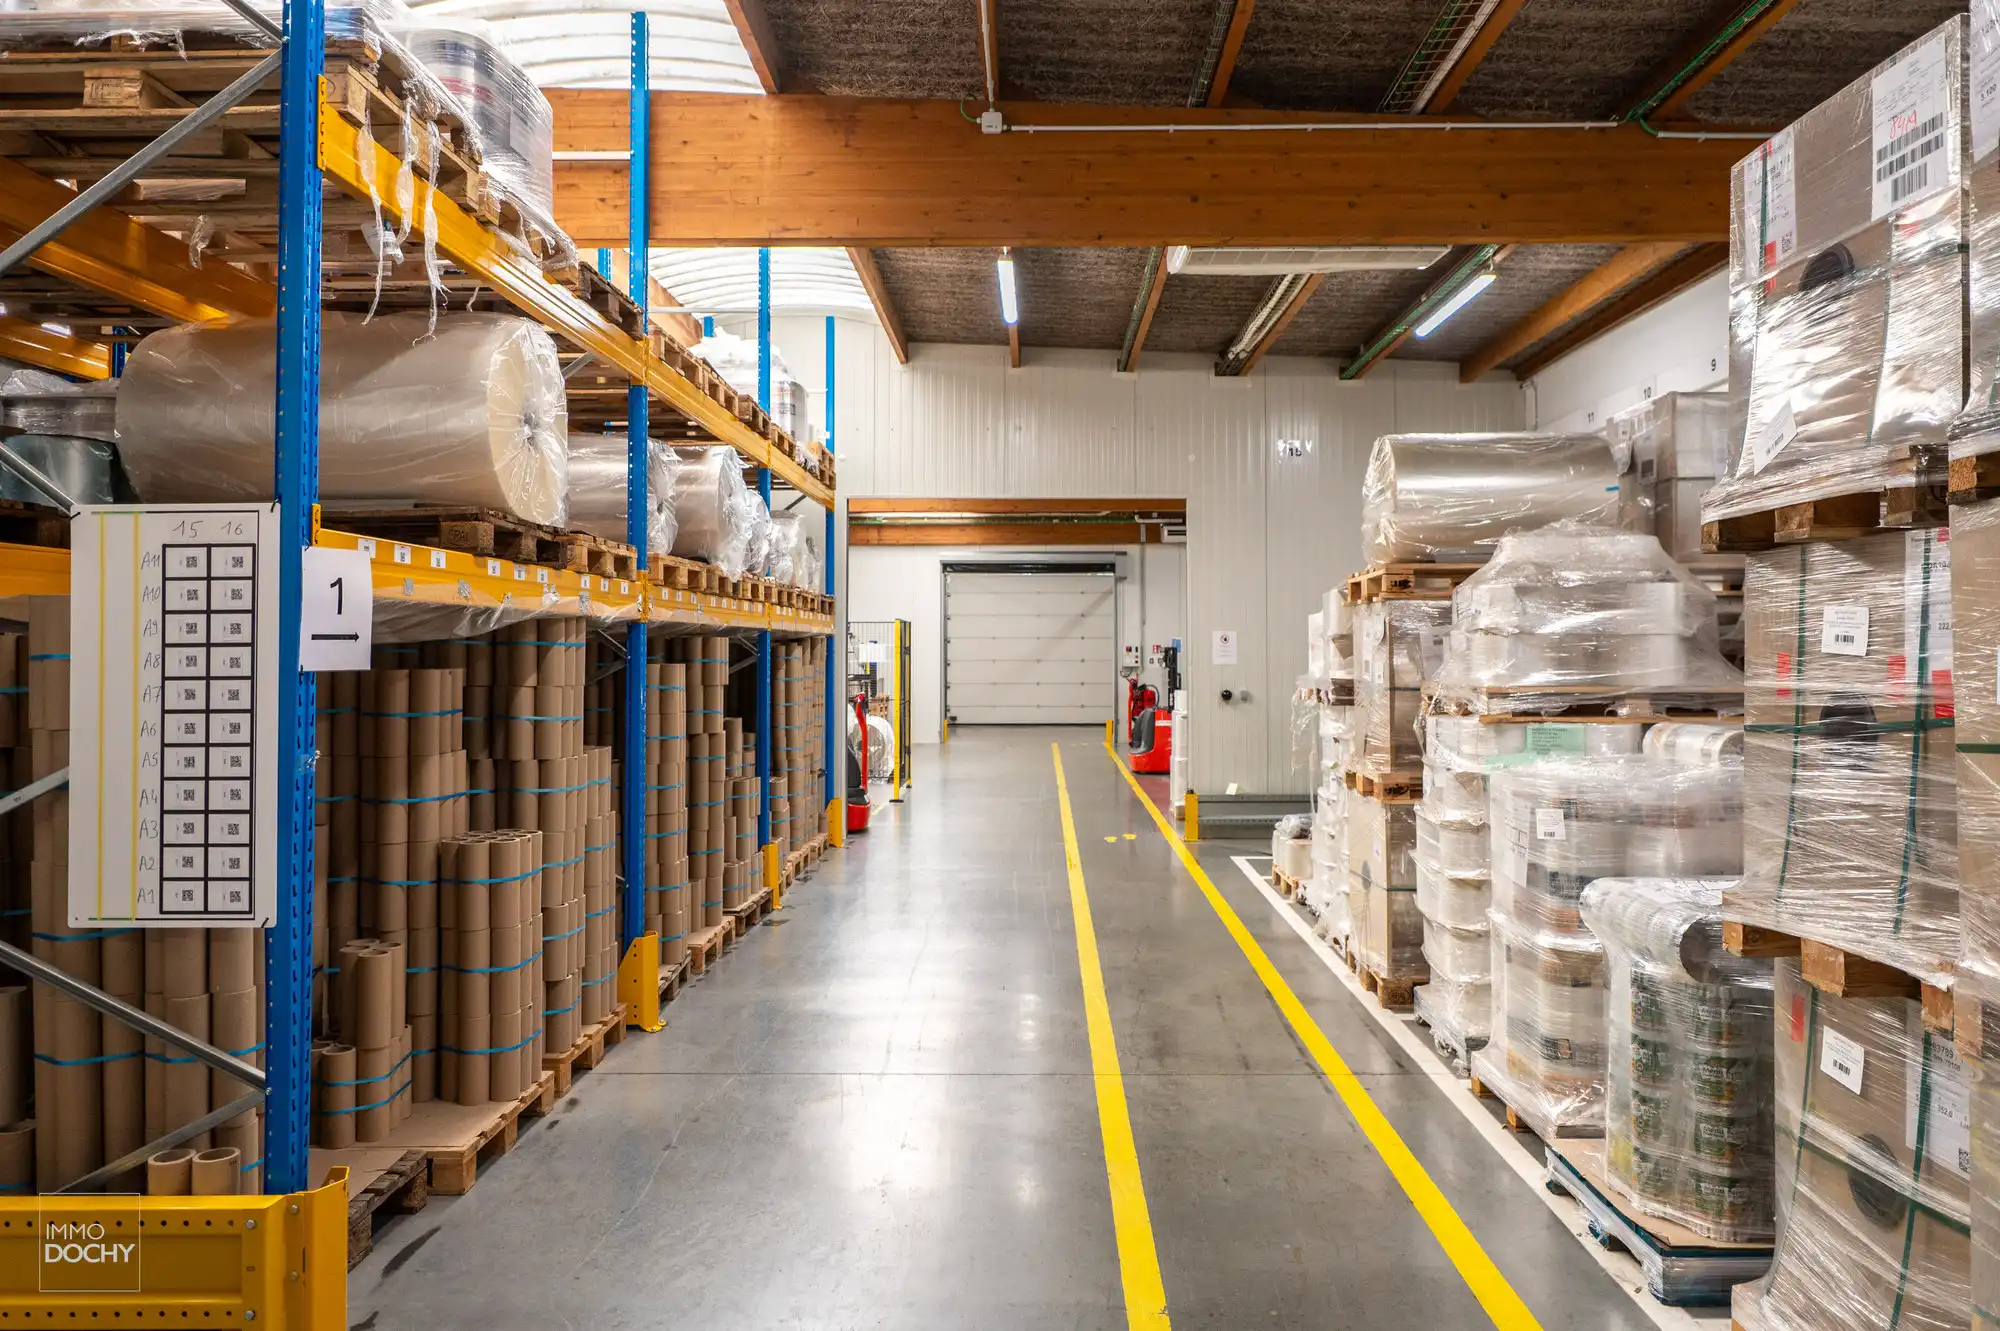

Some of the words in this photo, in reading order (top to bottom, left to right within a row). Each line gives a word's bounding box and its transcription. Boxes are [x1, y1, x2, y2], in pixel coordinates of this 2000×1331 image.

[1710, 358, 1717, 372] 9
[1643, 386, 1652, 400] 10
[1587, 412, 1595, 424] 11
[1288, 447, 1302, 457] 15
[172, 520, 204, 539] 15
[220, 521, 244, 536] 16
[141, 551, 161, 570] A11
[142, 585, 161, 604] A10
[329, 577, 343, 615] 1
[143, 618, 158, 637] A9
[143, 652, 161, 670] A8
[143, 684, 162, 704] A7
[140, 720, 157, 738] A6
[142, 751, 159, 768] A5
[139, 788, 158, 808] A4
[139, 817, 159, 839] A3
[139, 855, 156, 872] A2
[137, 887, 156, 904] A1
